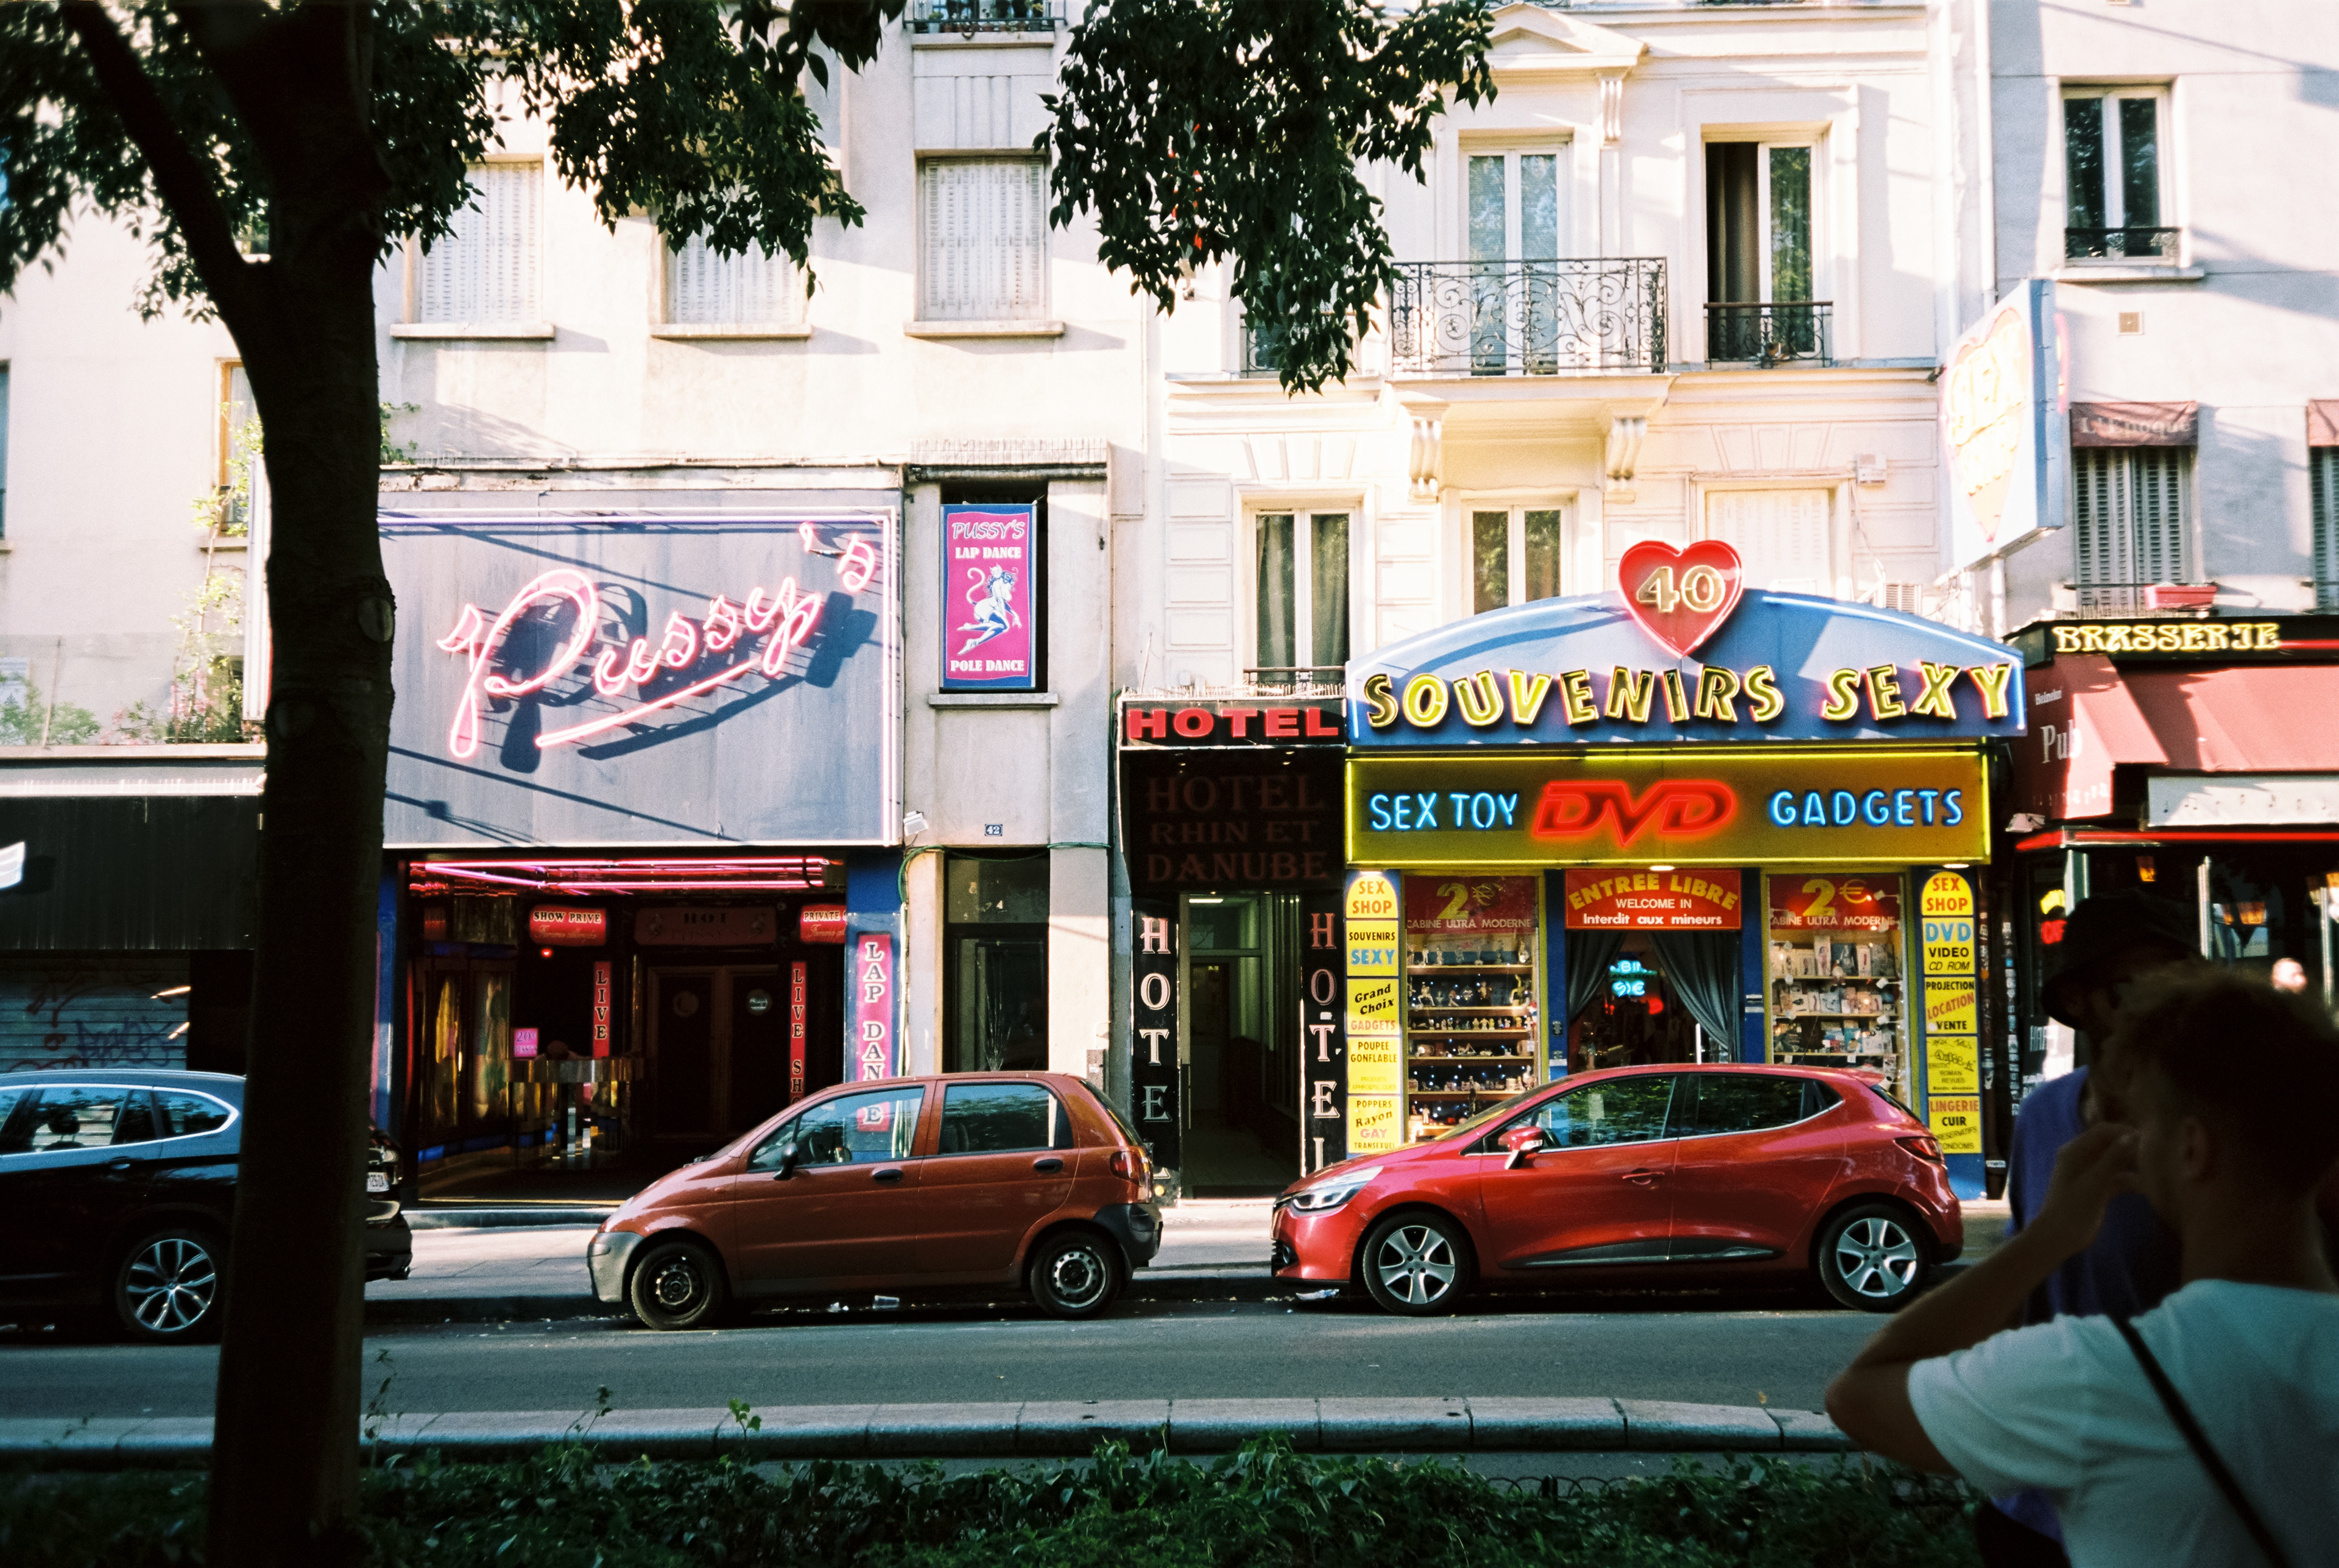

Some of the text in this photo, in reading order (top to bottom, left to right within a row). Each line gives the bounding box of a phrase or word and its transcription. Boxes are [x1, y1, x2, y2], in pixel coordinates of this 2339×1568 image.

[951, 519, 1025, 540] PUSSY'S
[955, 546, 1021, 559] LAP DANCE
[1636, 565, 1726, 613] 40
[436, 521, 876, 758] Pussy's
[2052, 623, 2281, 653] BRASSERIE
[950, 659, 1024, 672] POLE DANCE
[1363, 660, 2012, 728] SOUVENIRS SEXY
[1126, 707, 1339, 739] HOTEL
[2040, 719, 2083, 765] Pub
[1147, 775, 1327, 813] HOTEL
[1369, 780, 1964, 847] SEX TOY DVD GADGETS
[986, 825, 1001, 835] 42
[1150, 821, 1319, 845] RHIN ET
[1147, 852, 1330, 883] DANUBE
[1358, 881, 1385, 895] SEX
[1932, 877, 1961, 892] SEX
[1568, 873, 1738, 911] ENTREE LIBRE
[1352, 900, 1393, 914] SHOP
[1615, 898, 1692, 909] WELCOME IN
[1926, 897, 1968, 912] SHOP
[534, 911, 565, 923] SHOW
[803, 910, 841, 922] PRIVATE
[1584, 913, 1723, 925] Interdit aux mineurs
[1771, 916, 1802, 925] ABINE
[1807, 915, 1838, 925] ULTRA
[1406, 918, 1531, 929] CABINE ULTRA MODERNE
[1349, 931, 1395, 941] SOUVENIRS
[1925, 922, 1972, 943] DVD
[1350, 948, 1395, 966] SEXY
[1928, 947, 1969, 958] VIDEO
[1928, 961, 1970, 971] CD ROM
[1925, 980, 1975, 991] PROJECTION
[1354, 983, 1392, 1004] Grand
[595, 970, 609, 1040] LIVE
[792, 969, 805, 1039] LIVE
[1359, 997, 1395, 1016] Choix
[1927, 992, 1975, 1020] LOCATION
[1350, 1019, 1395, 1031] GADGETS
[1936, 1020, 1967, 1030] VENTE
[861, 941, 886, 1125] LAP DANE
[1358, 1041, 1389, 1051] POUPEE
[1350, 1053, 1397, 1063] GONFLABLE
[1356, 1100, 1392, 1109] POPPERS
[1929, 1100, 1979, 1112] LINGERIE
[1355, 1111, 1393, 1128] Rayon
[1942, 1116, 1967, 1127] CUIR
[1360, 1128, 1388, 1139] GAY
[1936, 1126, 1977, 1140] RESERVATIFS
